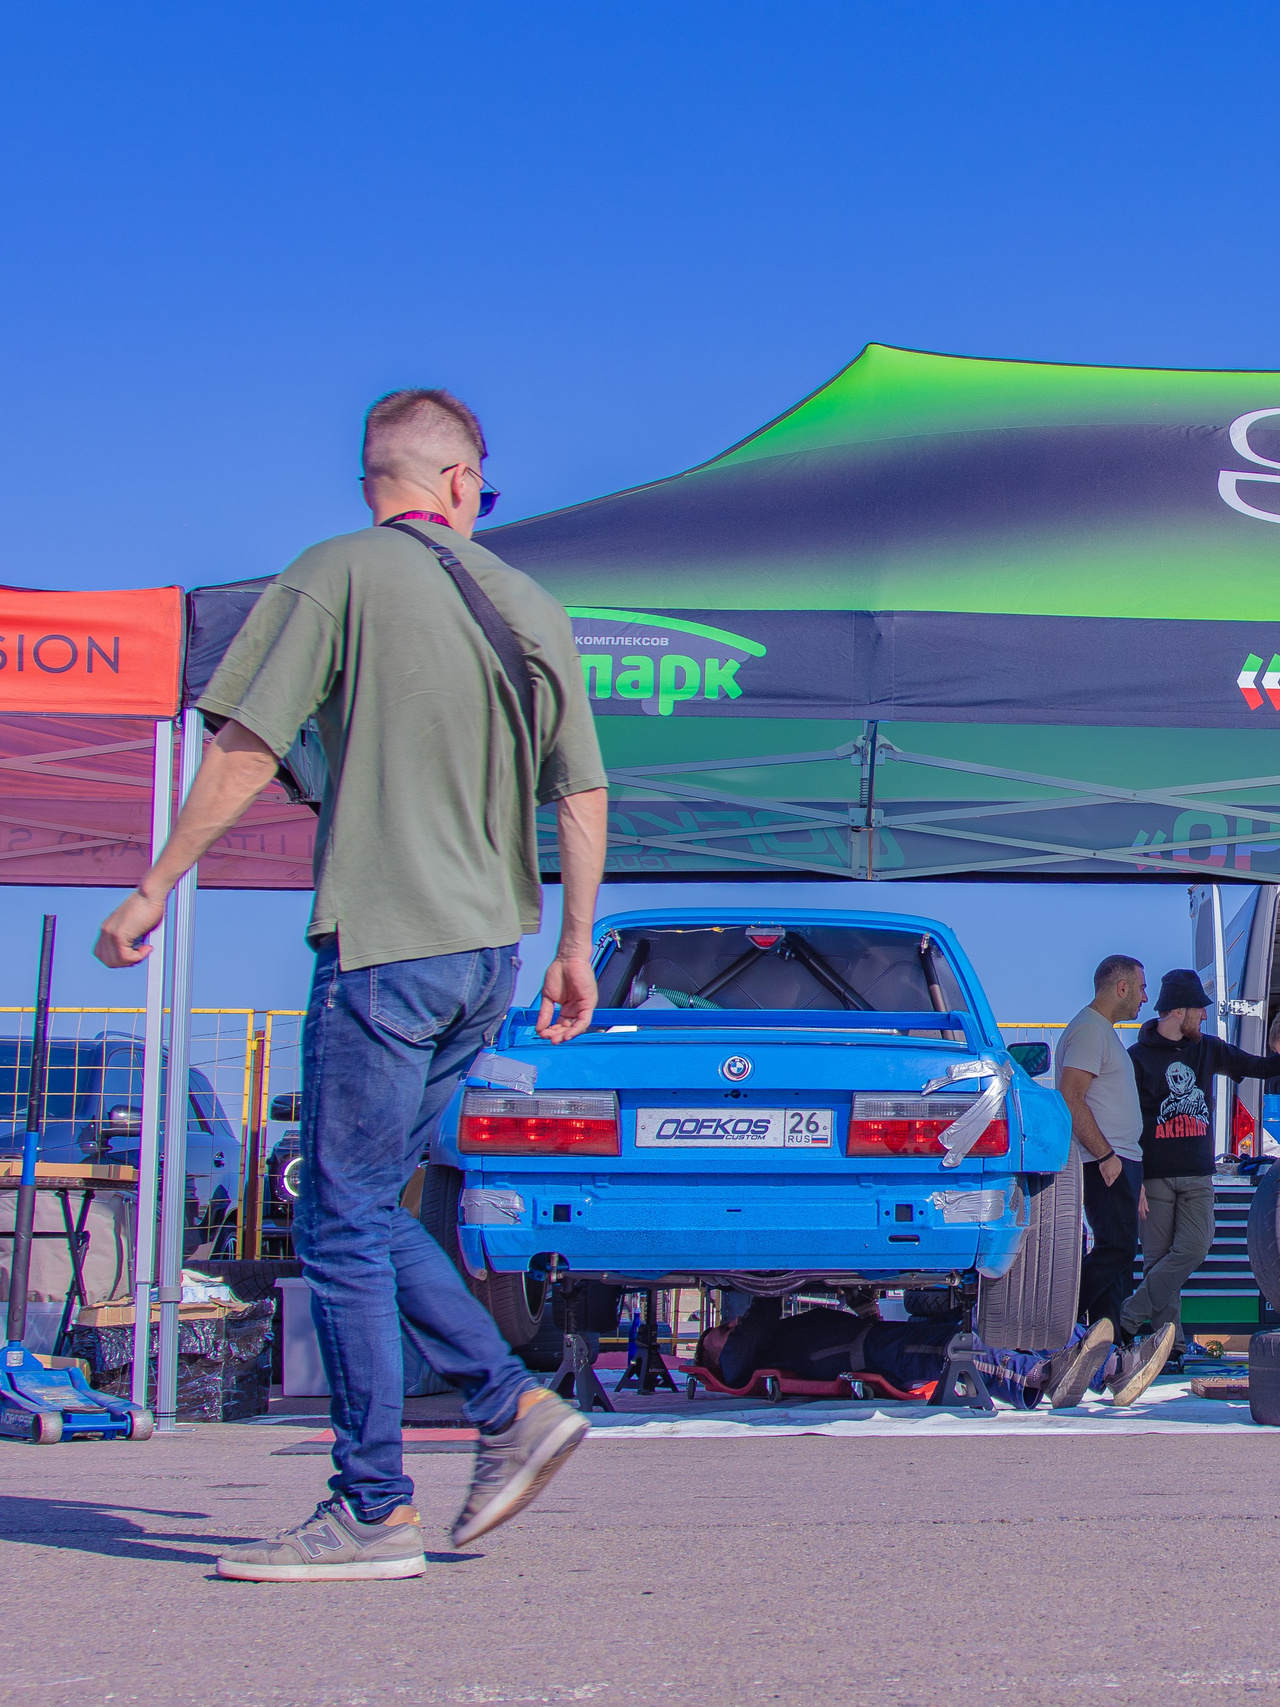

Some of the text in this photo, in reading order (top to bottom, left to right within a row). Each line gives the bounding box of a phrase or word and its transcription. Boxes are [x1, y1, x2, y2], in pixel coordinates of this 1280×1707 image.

[575, 636, 669, 646] КОМПЛЕКСОВ
[789, 1112, 819, 1134] 26
[1155, 1114, 1207, 1139] AKHMAT
[787, 1135, 811, 1144] RUS
